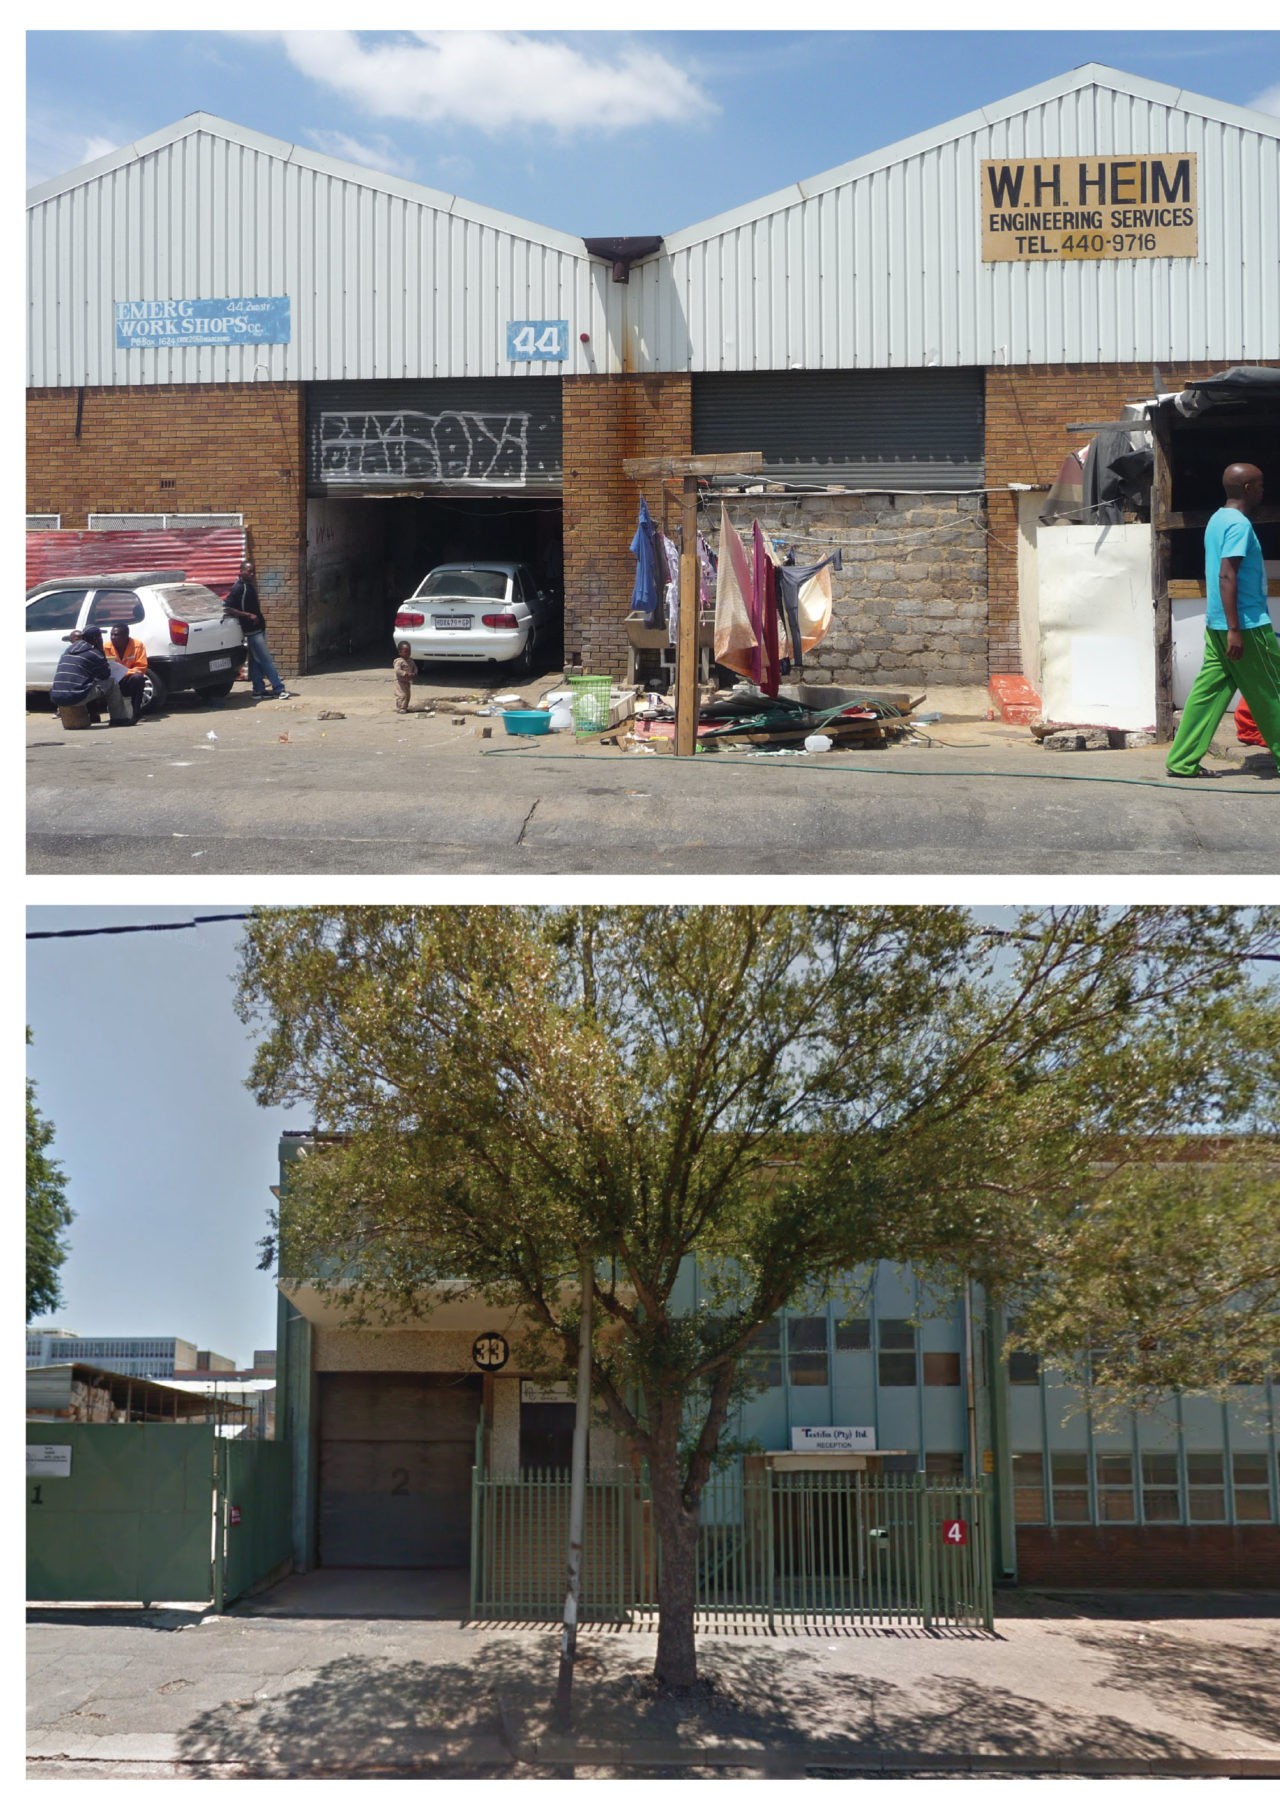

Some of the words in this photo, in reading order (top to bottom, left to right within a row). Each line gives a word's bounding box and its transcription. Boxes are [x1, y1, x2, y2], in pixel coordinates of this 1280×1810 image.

[988, 164, 1069, 208] W.H.
[1080, 159, 1190, 206] HEIM
[989, 210, 1102, 232] ENGINEERING
[1111, 208, 1193, 229] SERVICES
[1016, 236, 1058, 254] TEL.
[1062, 234, 1156, 252] 440-9716
[117, 301, 193, 319] EMERG
[513, 327, 560, 355] 44
[476, 1339, 505, 1365] 33
[31, 1484, 43, 1504] 1
[948, 1523, 962, 1542] 4
